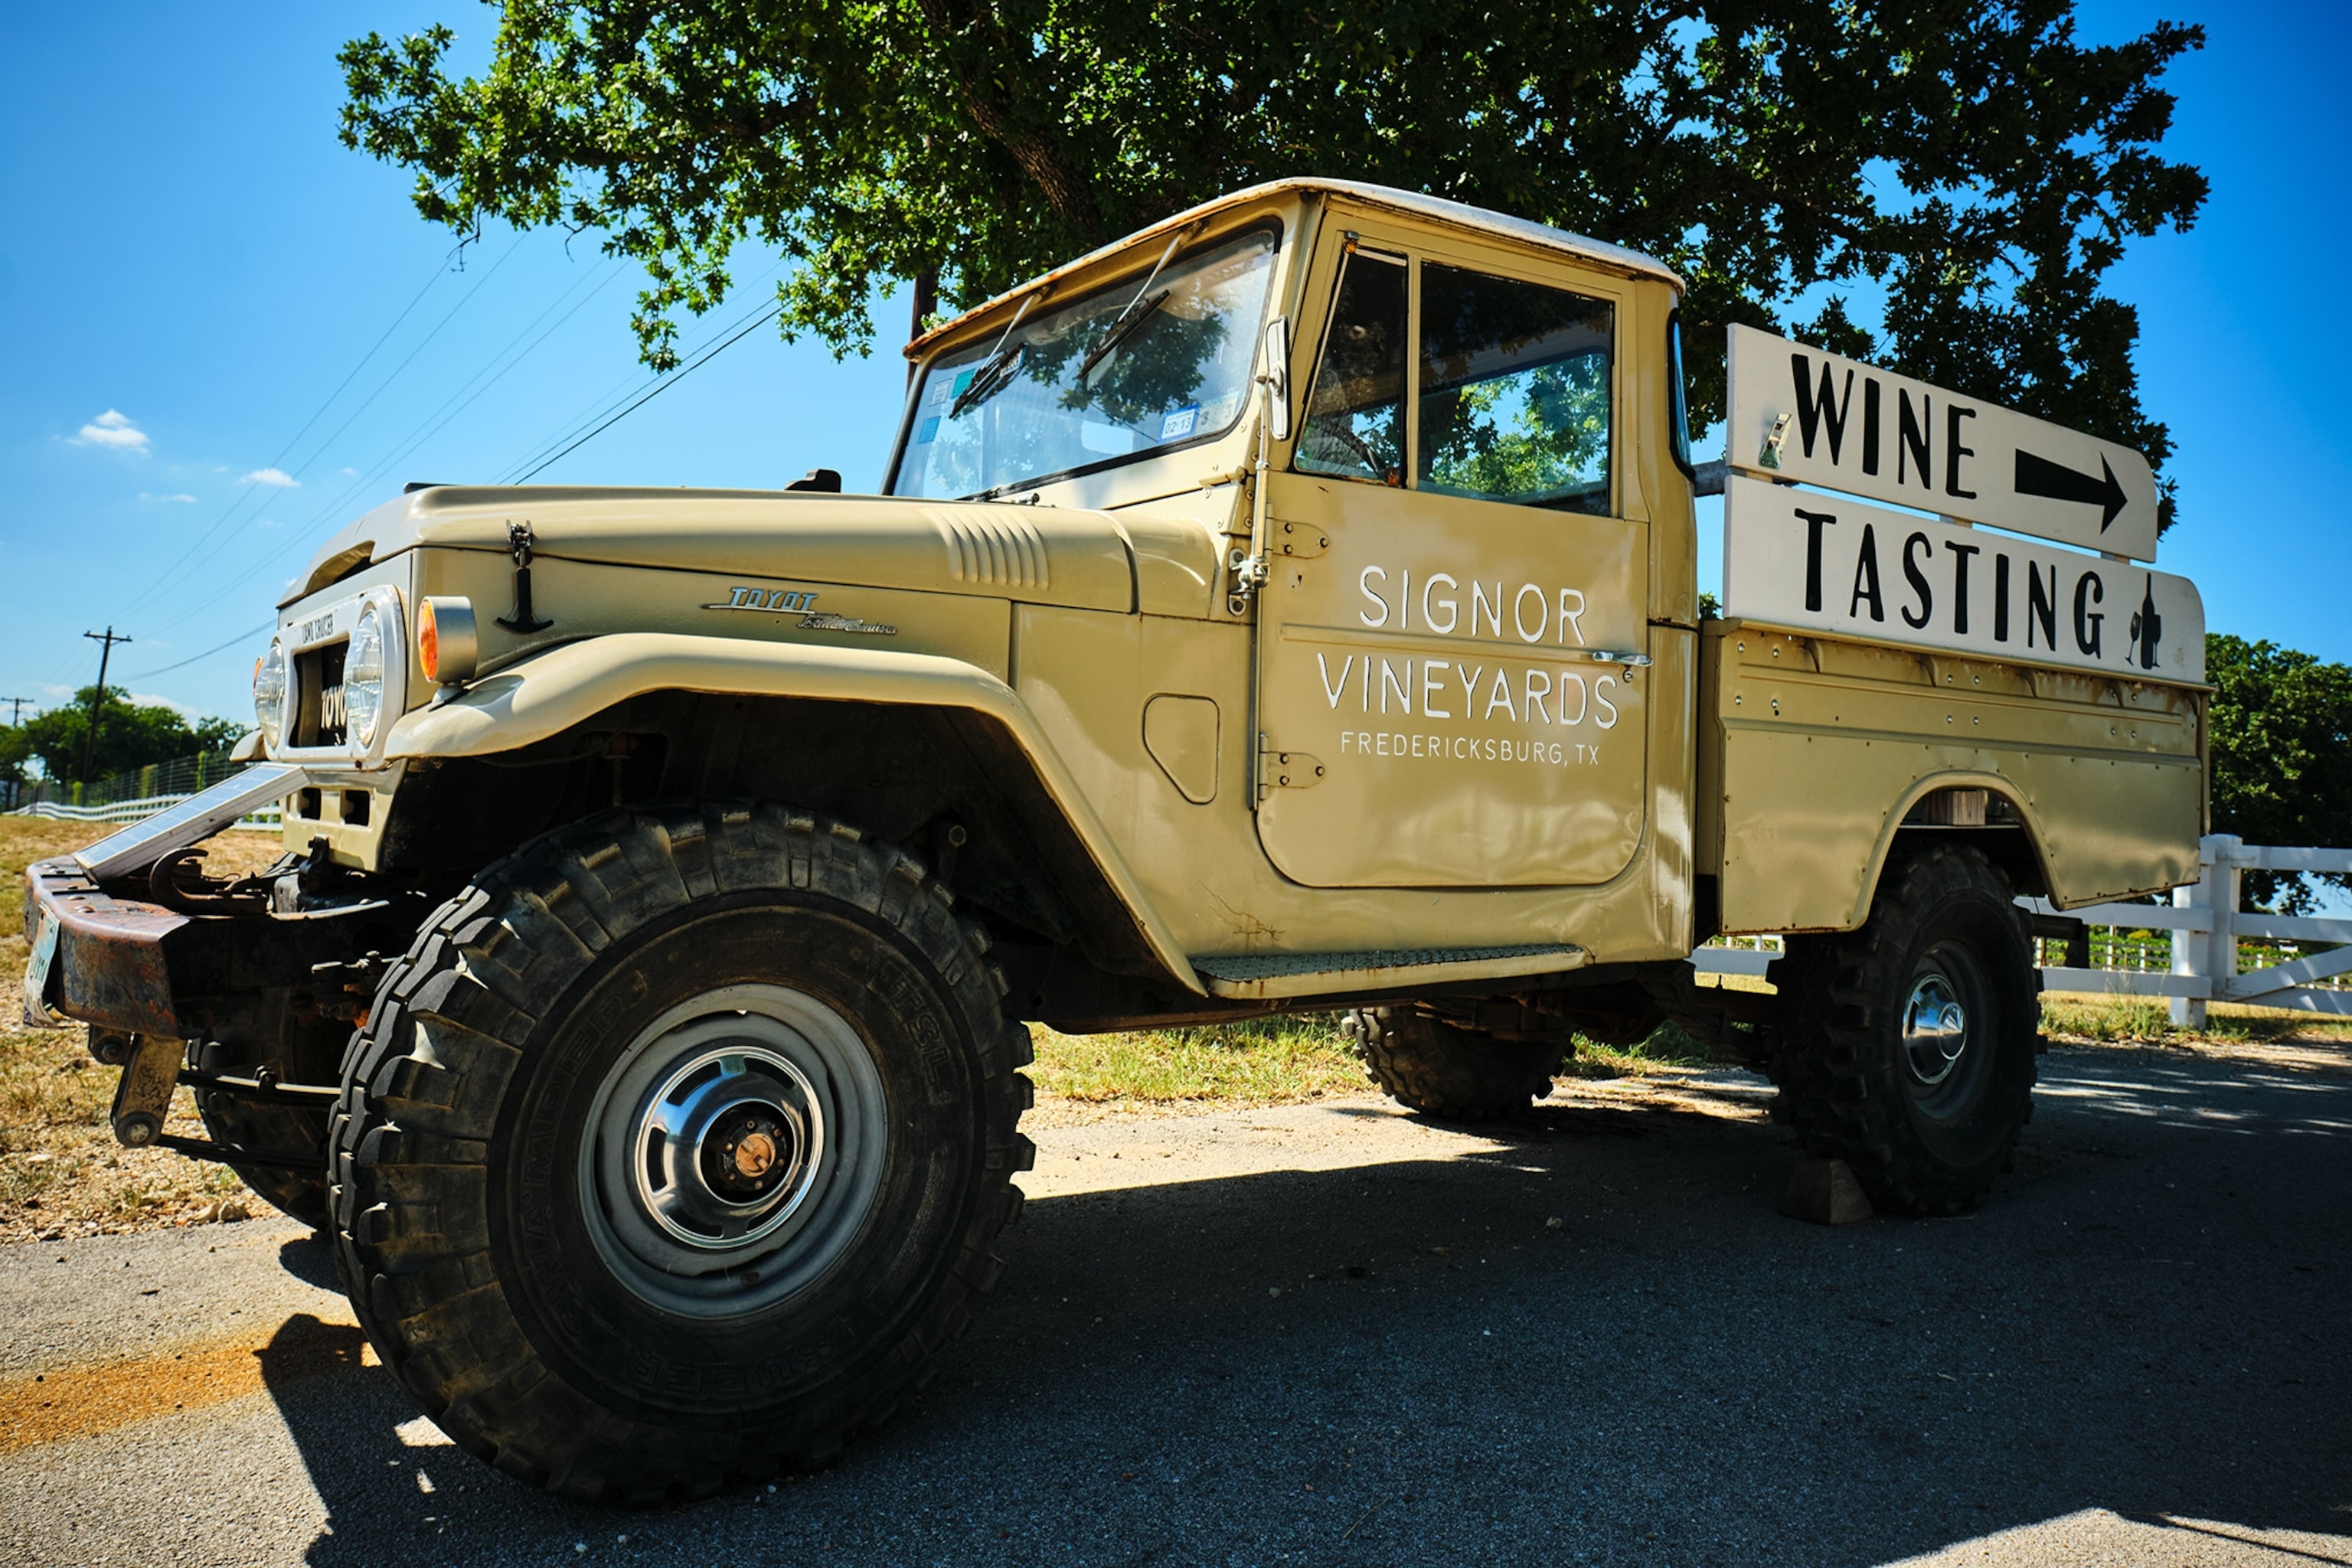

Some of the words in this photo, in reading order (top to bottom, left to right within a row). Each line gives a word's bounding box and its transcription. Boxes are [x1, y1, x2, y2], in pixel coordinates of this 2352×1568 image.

[1792, 354, 1977, 499] WINE
[730, 587, 818, 611] TOYOT
[1360, 566, 1586, 646] SIGNOR
[1794, 508, 2105, 659] TASTING
[1318, 652, 1619, 730] VINEYARDS
[1341, 732, 1568, 767] FREDERICKSBURG,
[1575, 745, 1600, 766] TX
